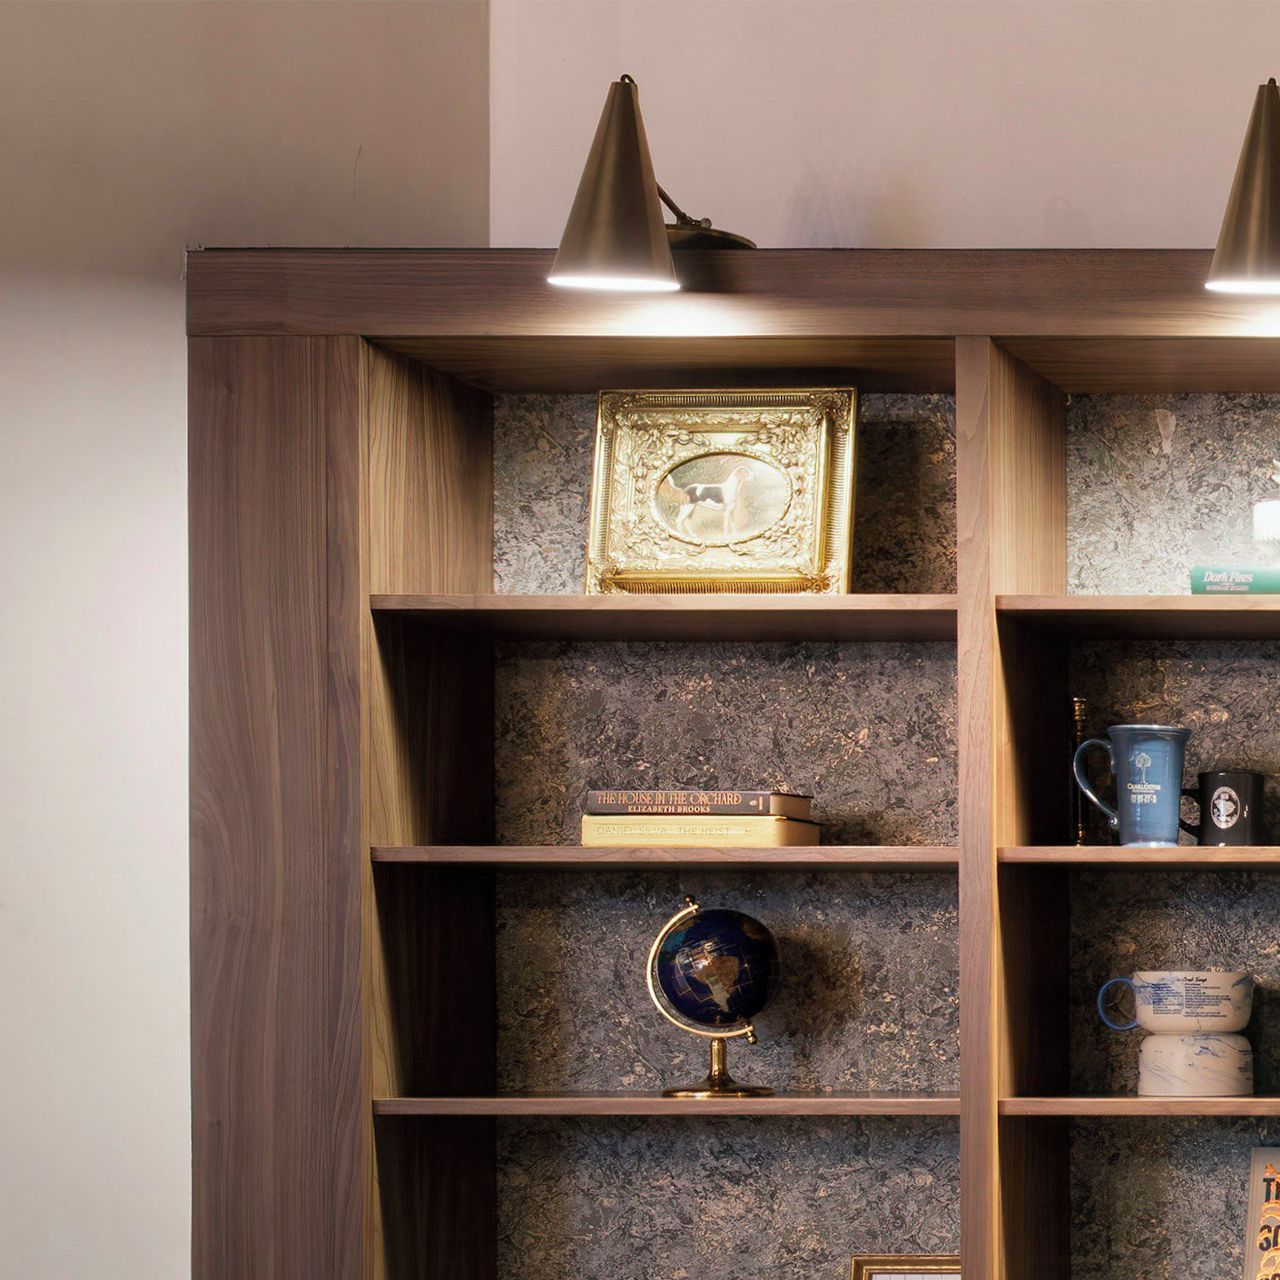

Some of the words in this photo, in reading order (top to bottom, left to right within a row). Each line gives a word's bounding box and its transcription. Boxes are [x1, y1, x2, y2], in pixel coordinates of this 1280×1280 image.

[597, 792, 615, 804] THE
[618, 793, 652, 805] HOUSE
[654, 793, 666, 804] IN
[669, 793, 687, 804] THE
[689, 793, 742, 805] ORCHARD
